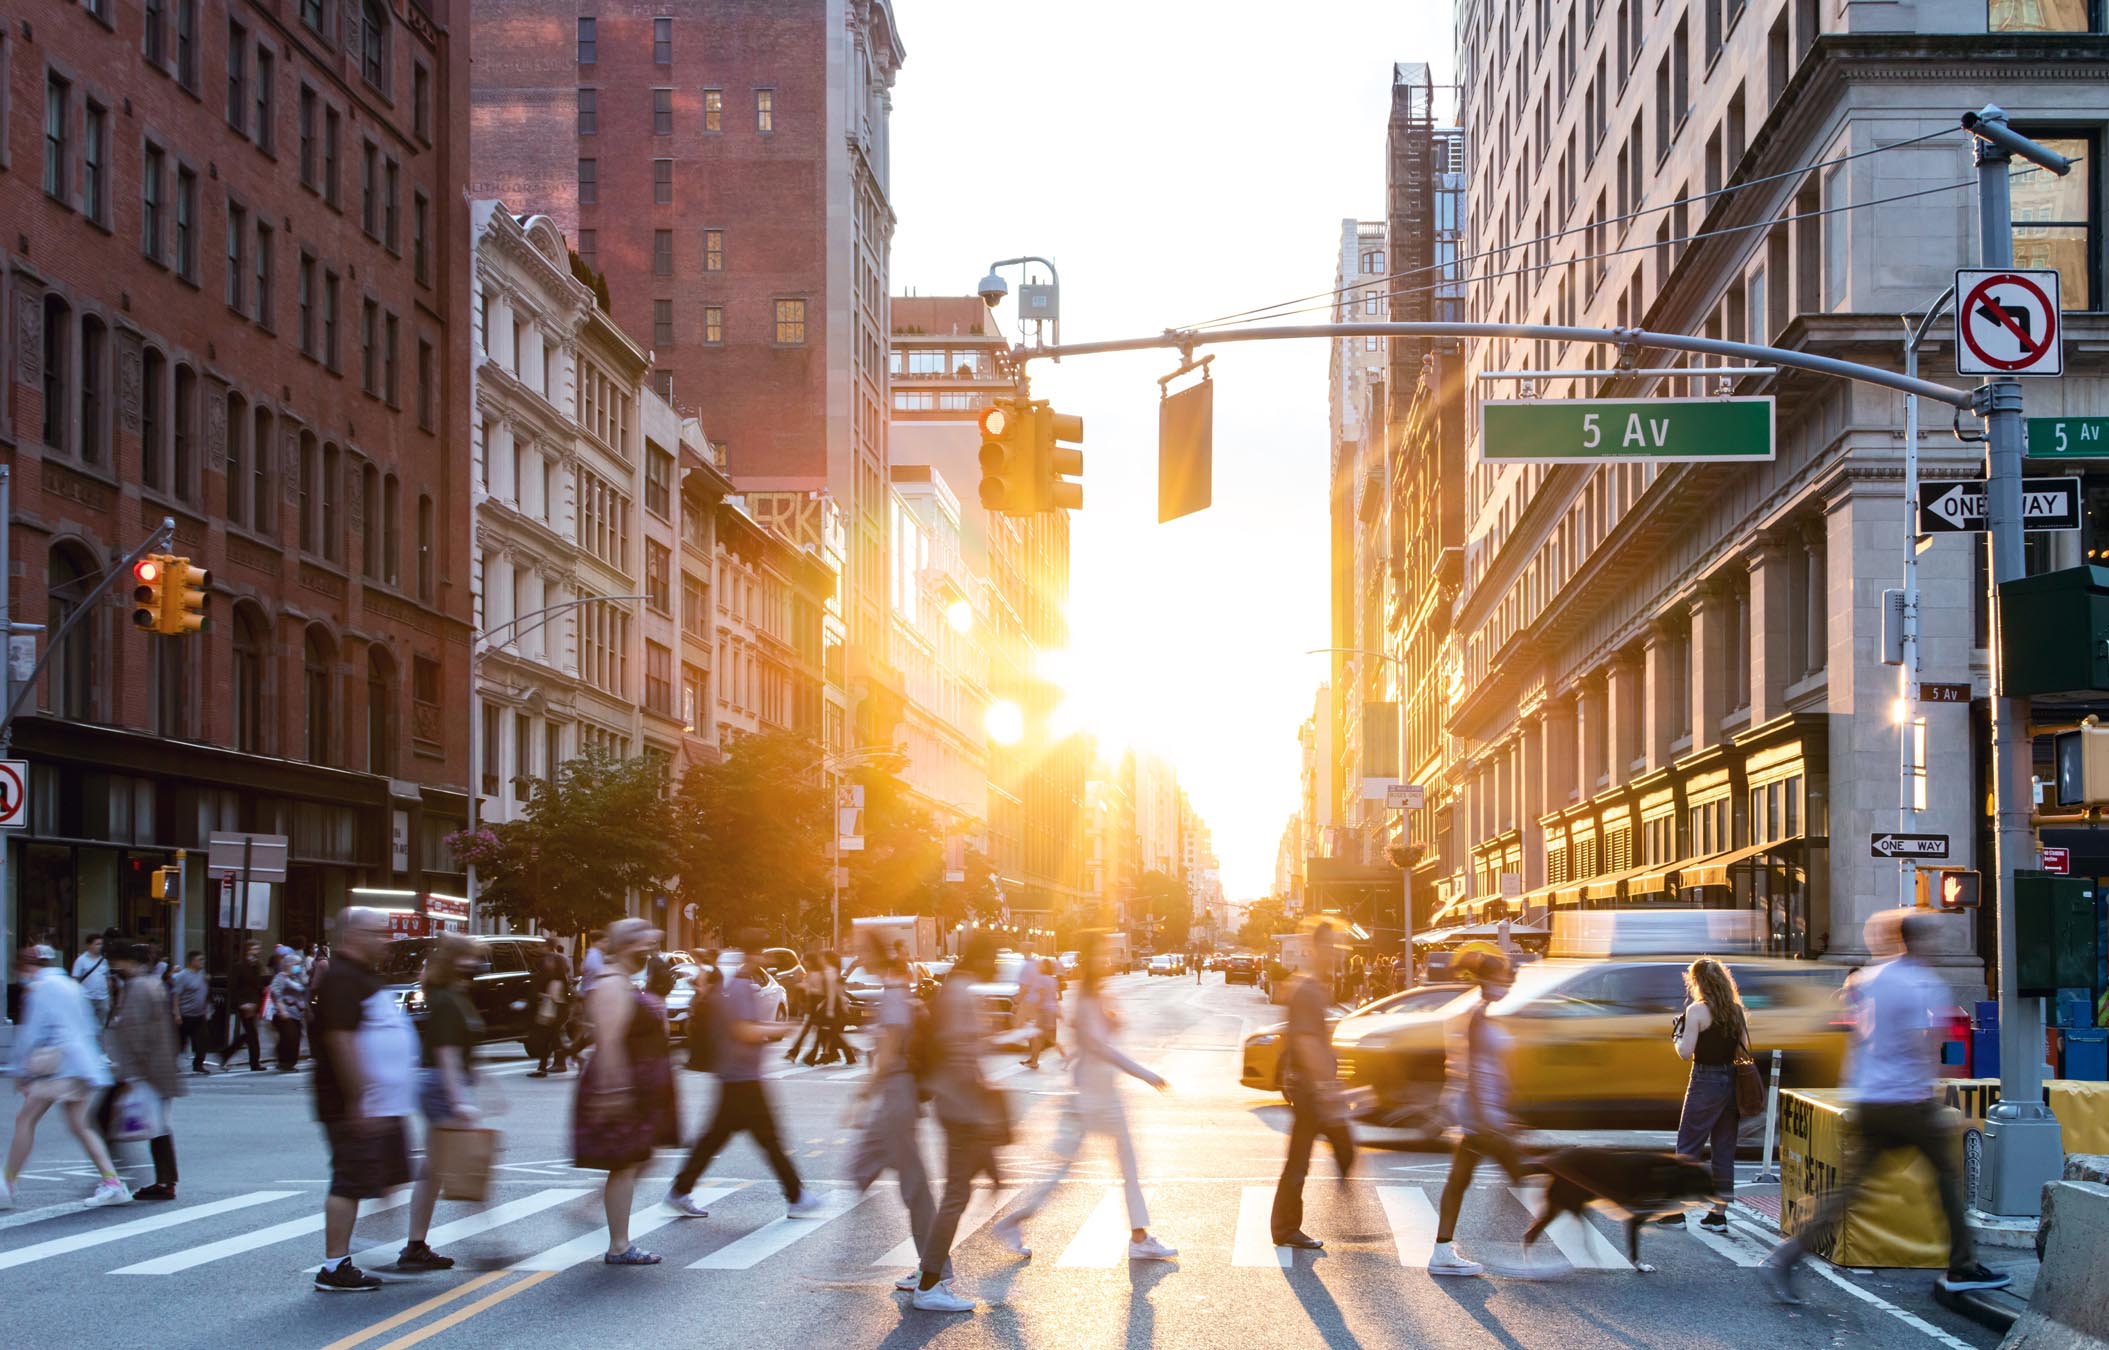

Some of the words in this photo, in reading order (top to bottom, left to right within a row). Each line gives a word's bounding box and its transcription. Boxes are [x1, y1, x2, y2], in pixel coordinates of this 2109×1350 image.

[1583, 413, 1601, 448] 5
[1622, 412, 1670, 448] Av
[2055, 423, 2068, 452] 5
[2080, 423, 2100, 441] Av
[1944, 497, 1989, 517] ONE
[1933, 687, 1939, 700] 5
[1943, 688, 1958, 700] Av
[1881, 840, 1905, 851] ONE
[1917, 841, 1942, 851] WAY
